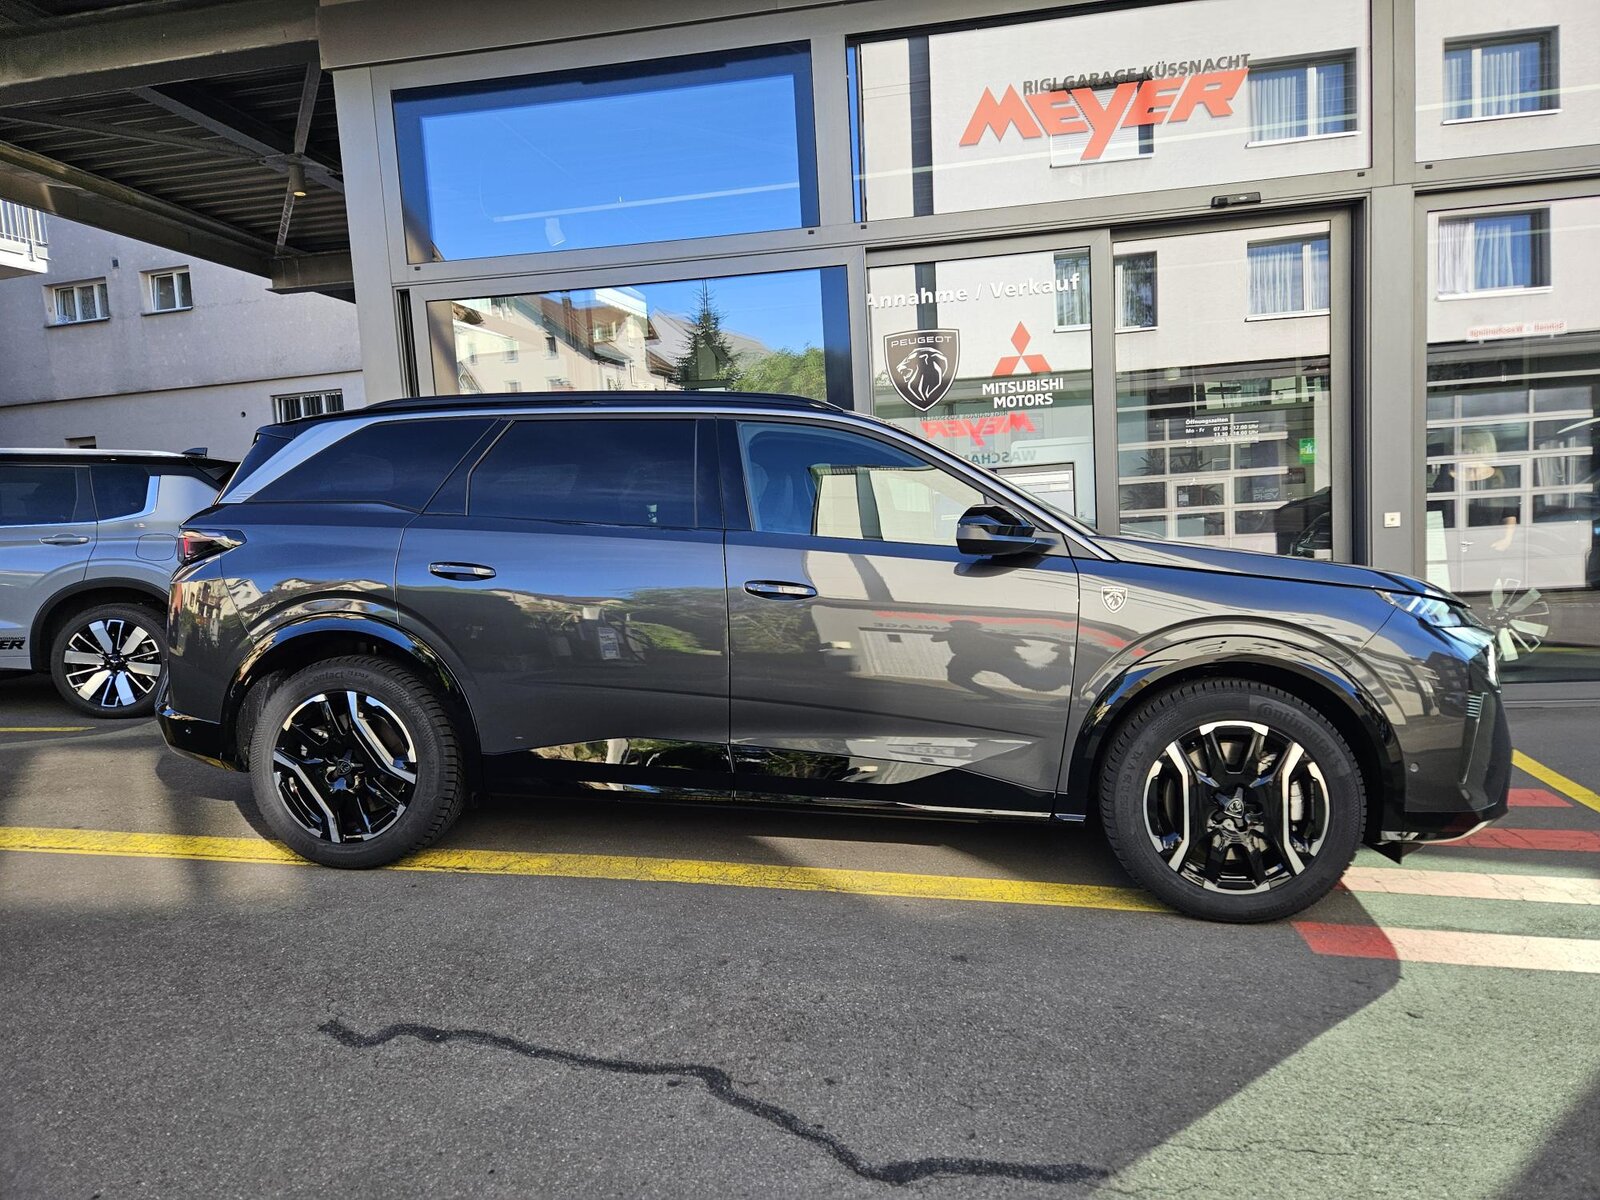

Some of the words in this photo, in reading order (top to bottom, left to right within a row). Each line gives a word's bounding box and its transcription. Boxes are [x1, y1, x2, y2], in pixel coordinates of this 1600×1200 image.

[1023, 79, 1057, 96] RIGI
[1063, 67, 1137, 90] GARAGE
[1142, 53, 1251, 80] KÜSSNACHT
[958, 67, 1251, 161] MEYER
[867, 288, 968, 309] Annahme
[989, 272, 1080, 298] Verkauf
[890, 335, 953, 349] PEUGEOT
[981, 377, 1065, 396] MITSUBISHI
[993, 393, 1054, 410] MOTORS
